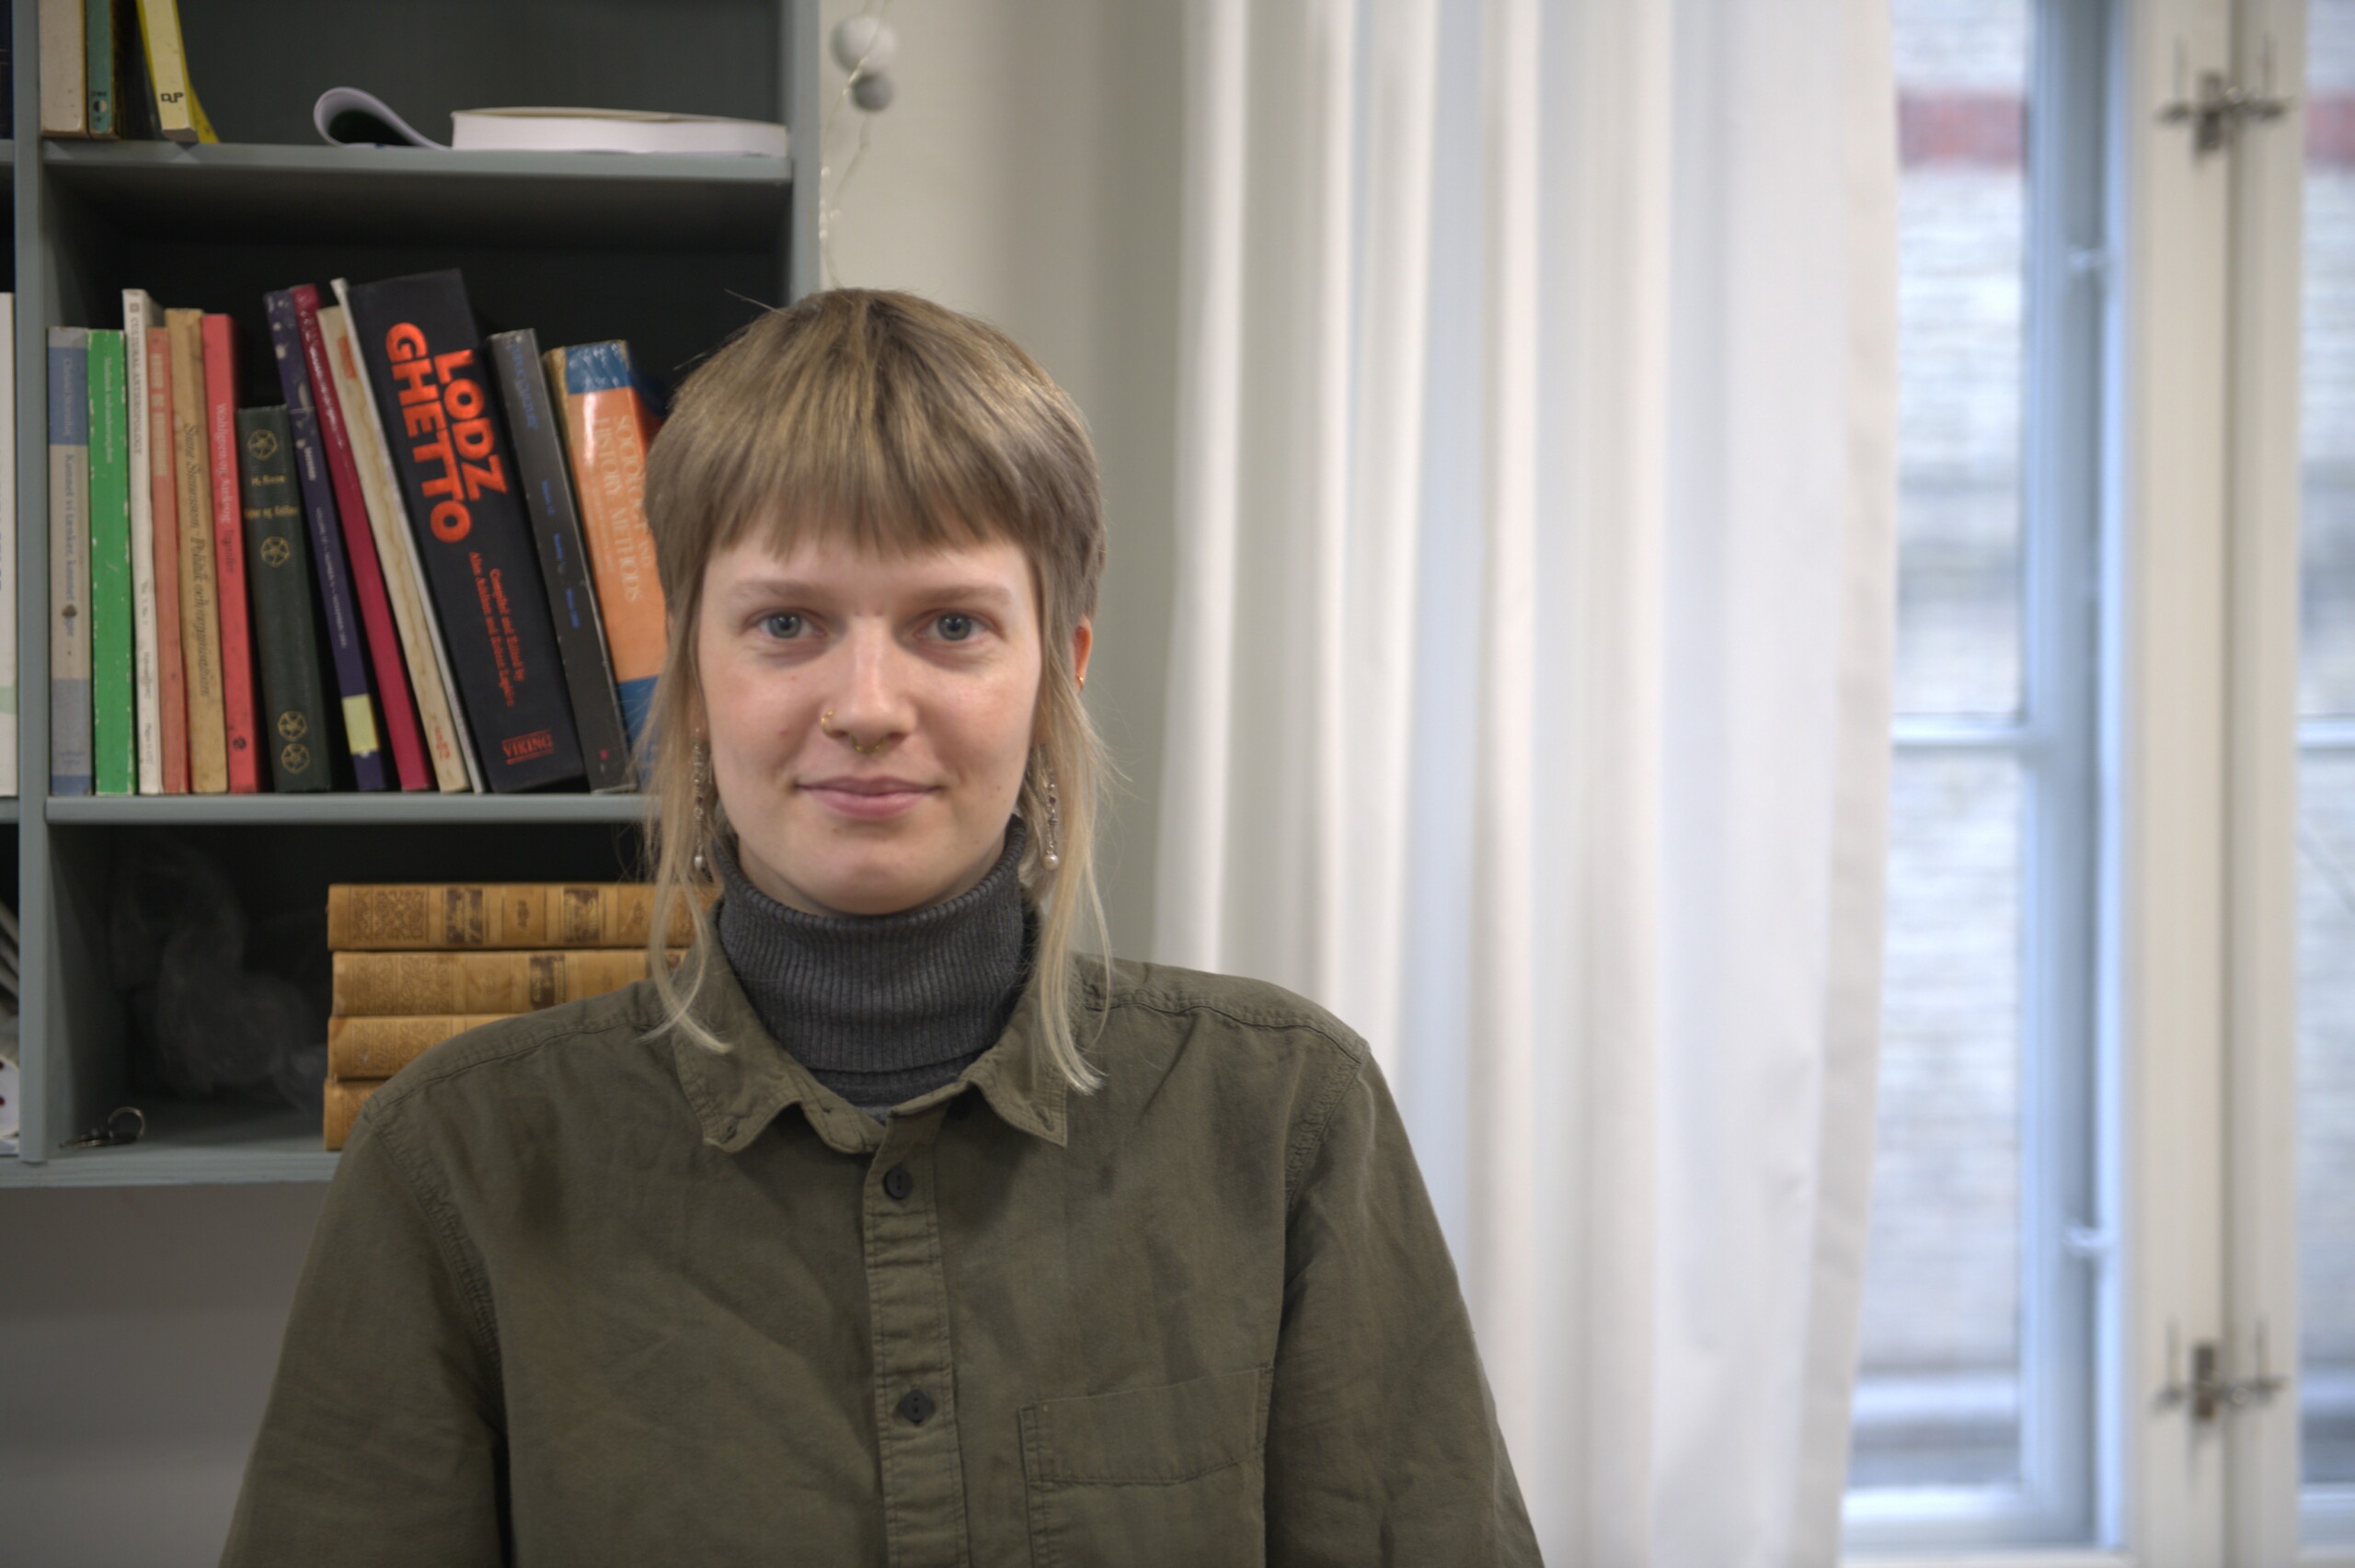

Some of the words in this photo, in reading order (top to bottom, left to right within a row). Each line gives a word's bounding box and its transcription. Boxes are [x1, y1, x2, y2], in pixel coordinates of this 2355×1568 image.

[132, 372, 143, 455] ANTHROPOLOGY
[385, 322, 472, 544] GHETTO
[433, 349, 508, 501] LODZ
[612, 508, 643, 604] METHODS
[489, 567, 511, 614] Compiled
[486, 615, 500, 635] and
[501, 616, 516, 635] and
[490, 635, 505, 670] Robert
[506, 635, 524, 668] Edited
[503, 735, 554, 758] VIKING
